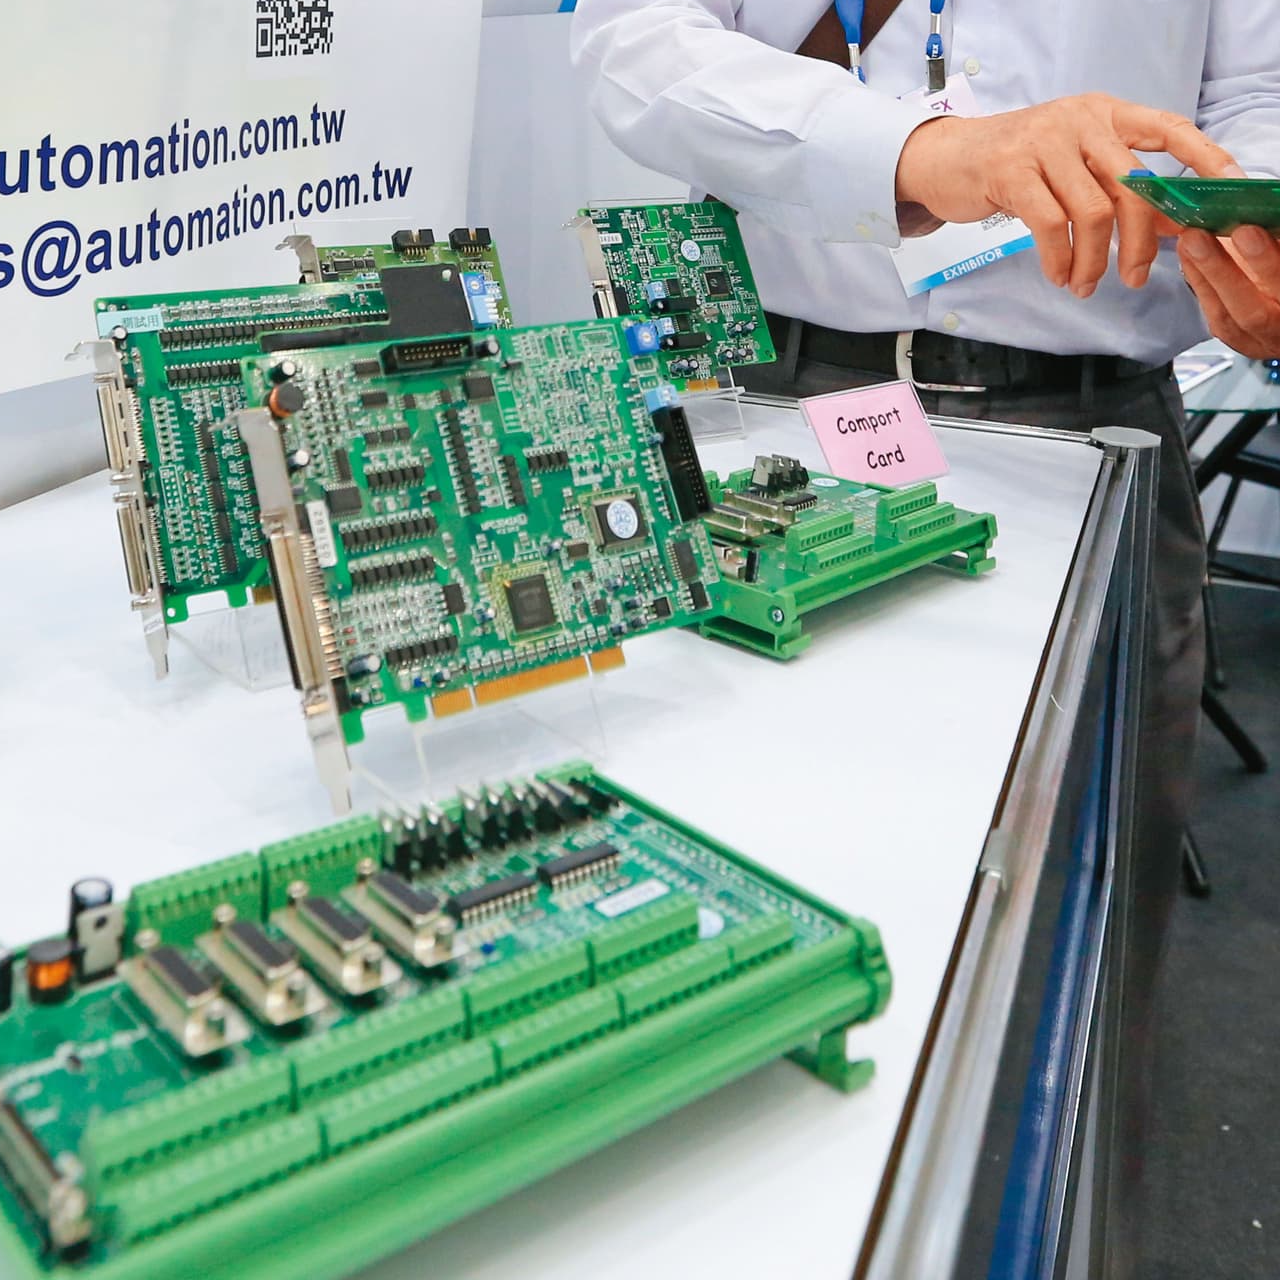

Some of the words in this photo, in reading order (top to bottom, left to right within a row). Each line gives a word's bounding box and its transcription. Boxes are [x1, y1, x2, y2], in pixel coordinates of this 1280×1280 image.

[942, 247, 1005, 282] EXHIBITOR
[836, 407, 902, 438] Comport
[866, 443, 907, 469] Card
